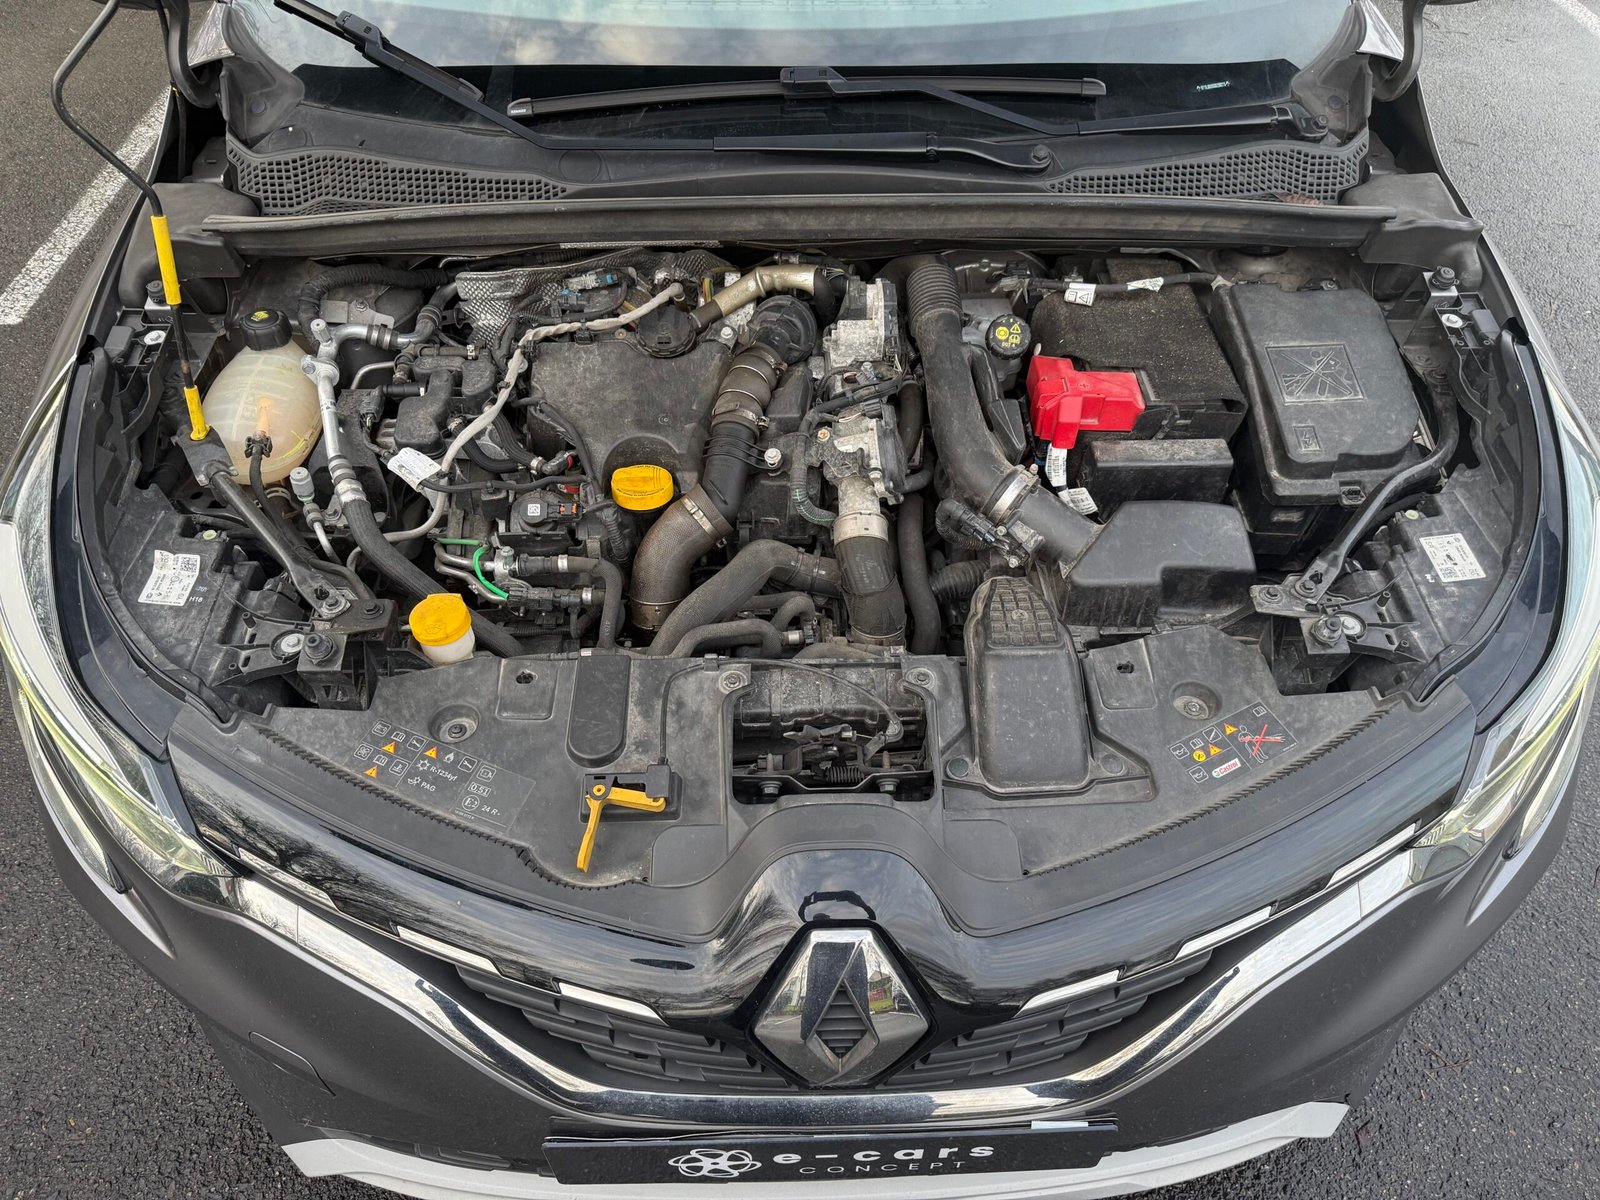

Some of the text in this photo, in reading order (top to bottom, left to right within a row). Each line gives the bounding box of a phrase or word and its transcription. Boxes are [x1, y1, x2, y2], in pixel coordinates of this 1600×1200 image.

[1218, 760, 1239, 775] Castrol
[430, 766, 457, 781] R-1234yf
[420, 781, 436, 791] PAG
[470, 784, 488, 795] 0.51
[464, 797, 477, 807] E2
[481, 804, 490, 812] 24
[773, 1146, 994, 1164] e-cars
[799, 1162, 966, 1174] CONCEPT
